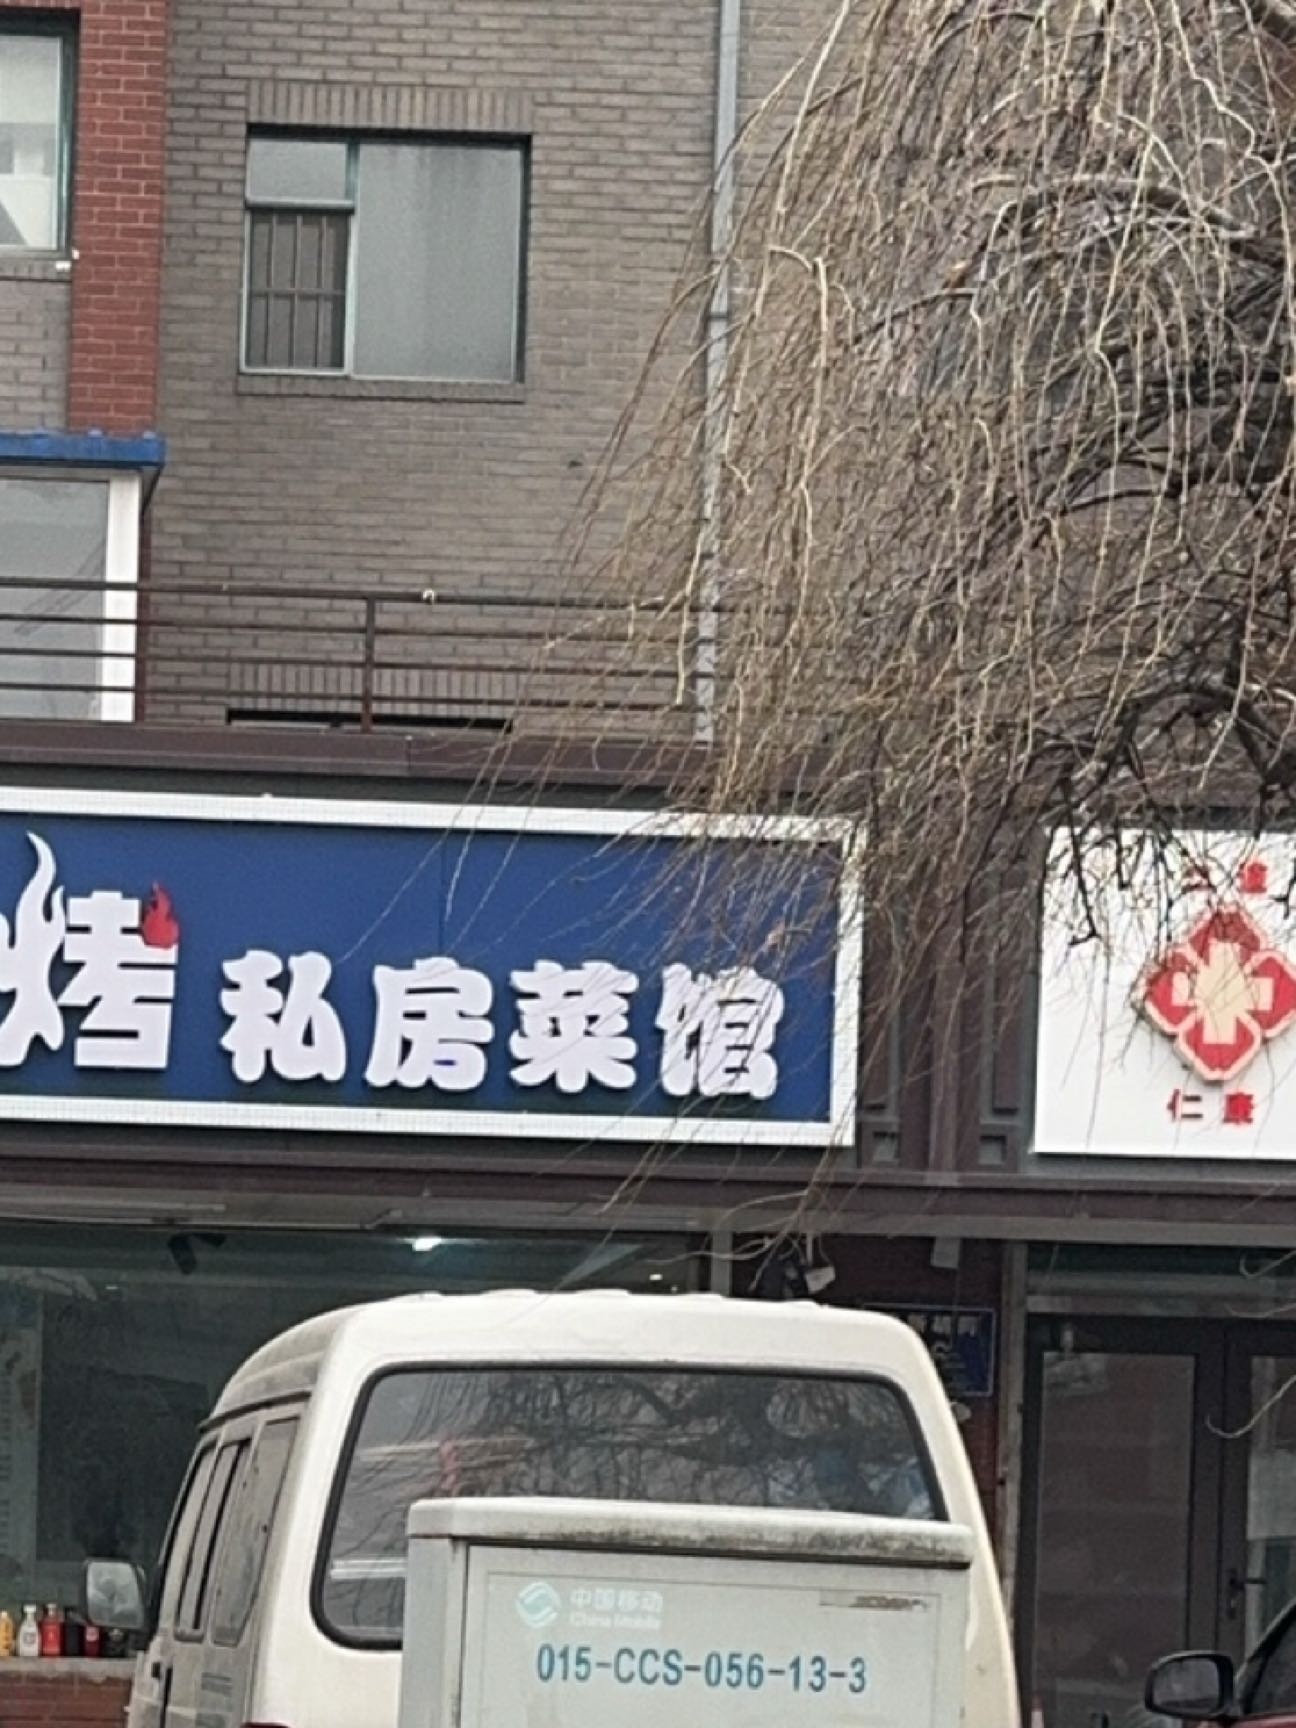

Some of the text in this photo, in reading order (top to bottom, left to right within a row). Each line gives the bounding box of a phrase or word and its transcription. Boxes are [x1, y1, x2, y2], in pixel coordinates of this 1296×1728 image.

[219, 948, 786, 1101] 私房菜馆
[568, 1587, 664, 1614] 中国移动
[536, 1643, 867, 1693] 015-CCS-056-13-3
